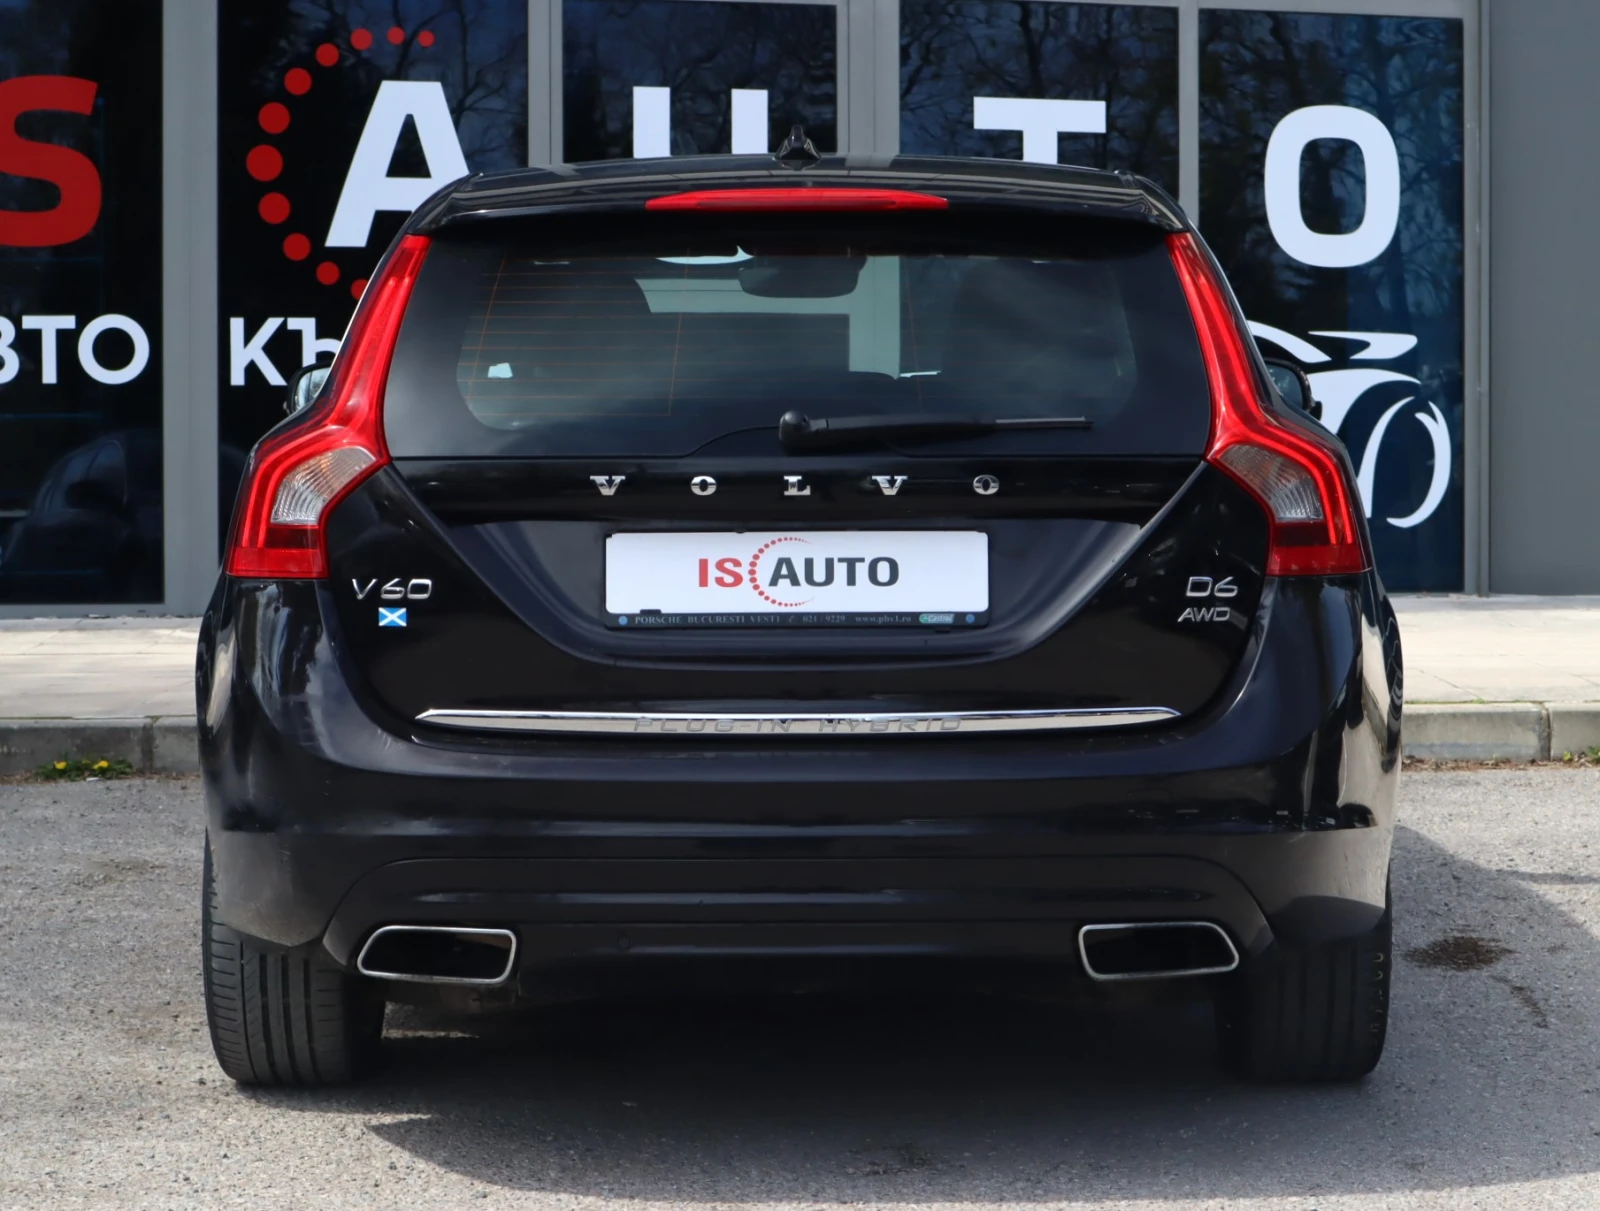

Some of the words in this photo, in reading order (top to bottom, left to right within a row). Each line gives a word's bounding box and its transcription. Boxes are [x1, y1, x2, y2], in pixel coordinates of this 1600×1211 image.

[589, 474, 1000, 497] VOLVO
[698, 557, 744, 588] IS
[768, 556, 900, 588] AUTO
[351, 578, 433, 600] V60
[1186, 576, 1239, 597] D6
[634, 615, 682, 625] PORSCHE
[1177, 606, 1231, 622] AWD
[633, 718, 793, 733] PLUG-IN
[818, 717, 962, 733] HYBRID
